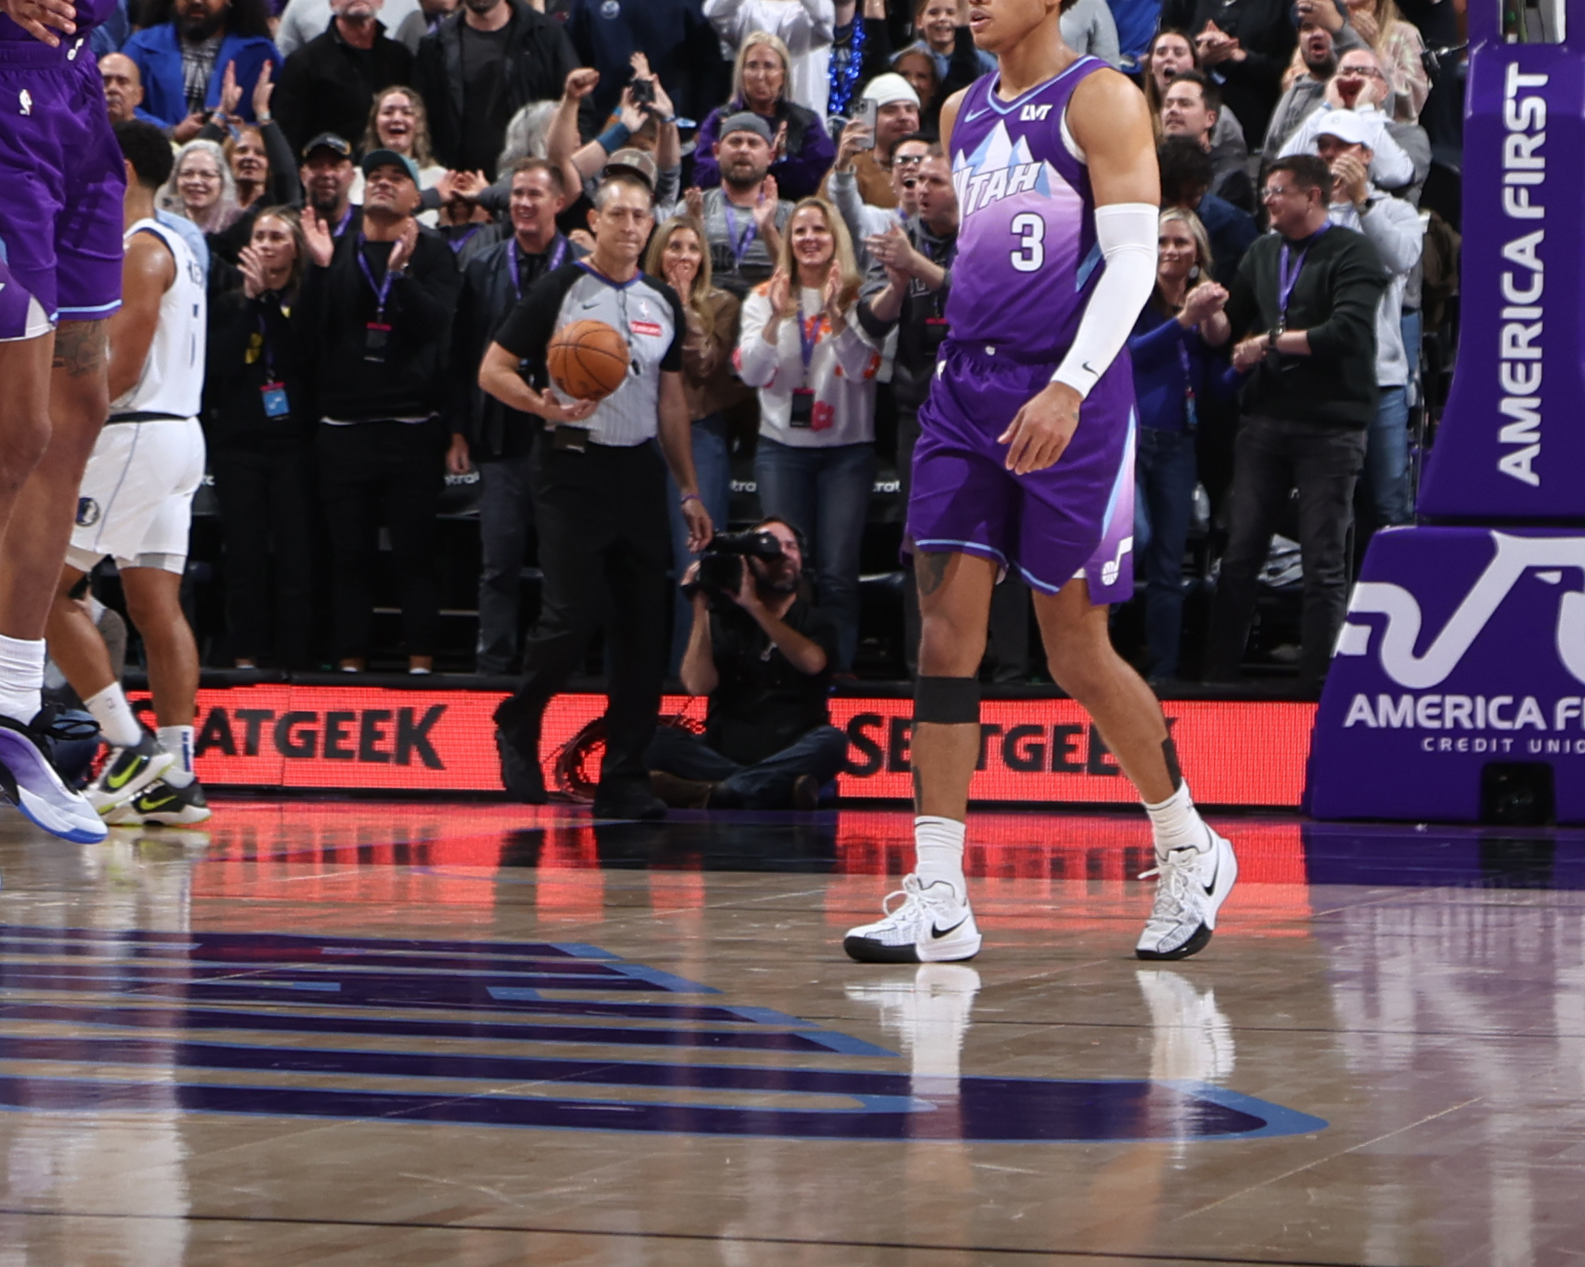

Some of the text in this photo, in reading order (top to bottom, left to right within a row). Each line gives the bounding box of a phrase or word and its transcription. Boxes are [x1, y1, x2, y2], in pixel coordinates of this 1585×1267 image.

[1019, 103, 1054, 121] LVT
[1010, 212, 1046, 273] 3
[1496, 62, 1549, 488] AMERICA FIRST
[128, 700, 448, 770] ATGEEK
[1343, 693, 1547, 730] AMERICA
[841, 713, 1179, 777] SETGEE
[1422, 737, 1514, 753] CREDIT
